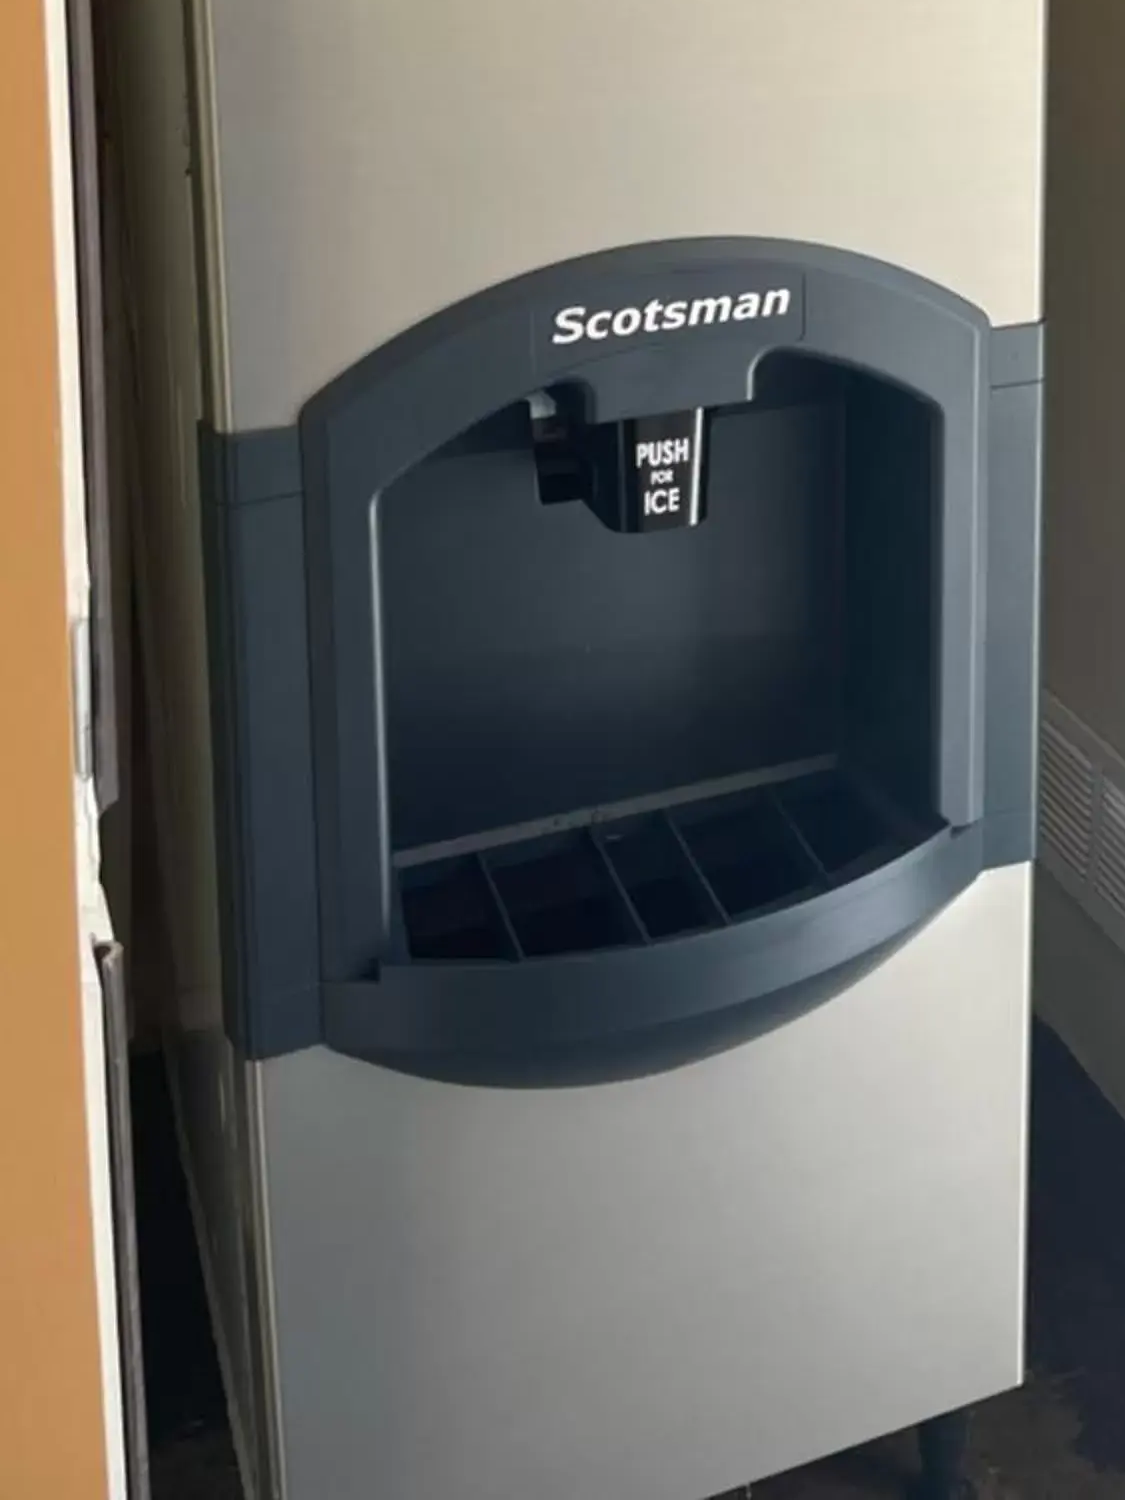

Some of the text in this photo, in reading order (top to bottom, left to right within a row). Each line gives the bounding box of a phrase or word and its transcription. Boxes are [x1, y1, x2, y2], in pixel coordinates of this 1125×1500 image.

[552, 287, 791, 345] Scotsman
[636, 438, 689, 468] PUSH
[650, 470, 674, 485] FOR
[643, 487, 681, 515] ICE
